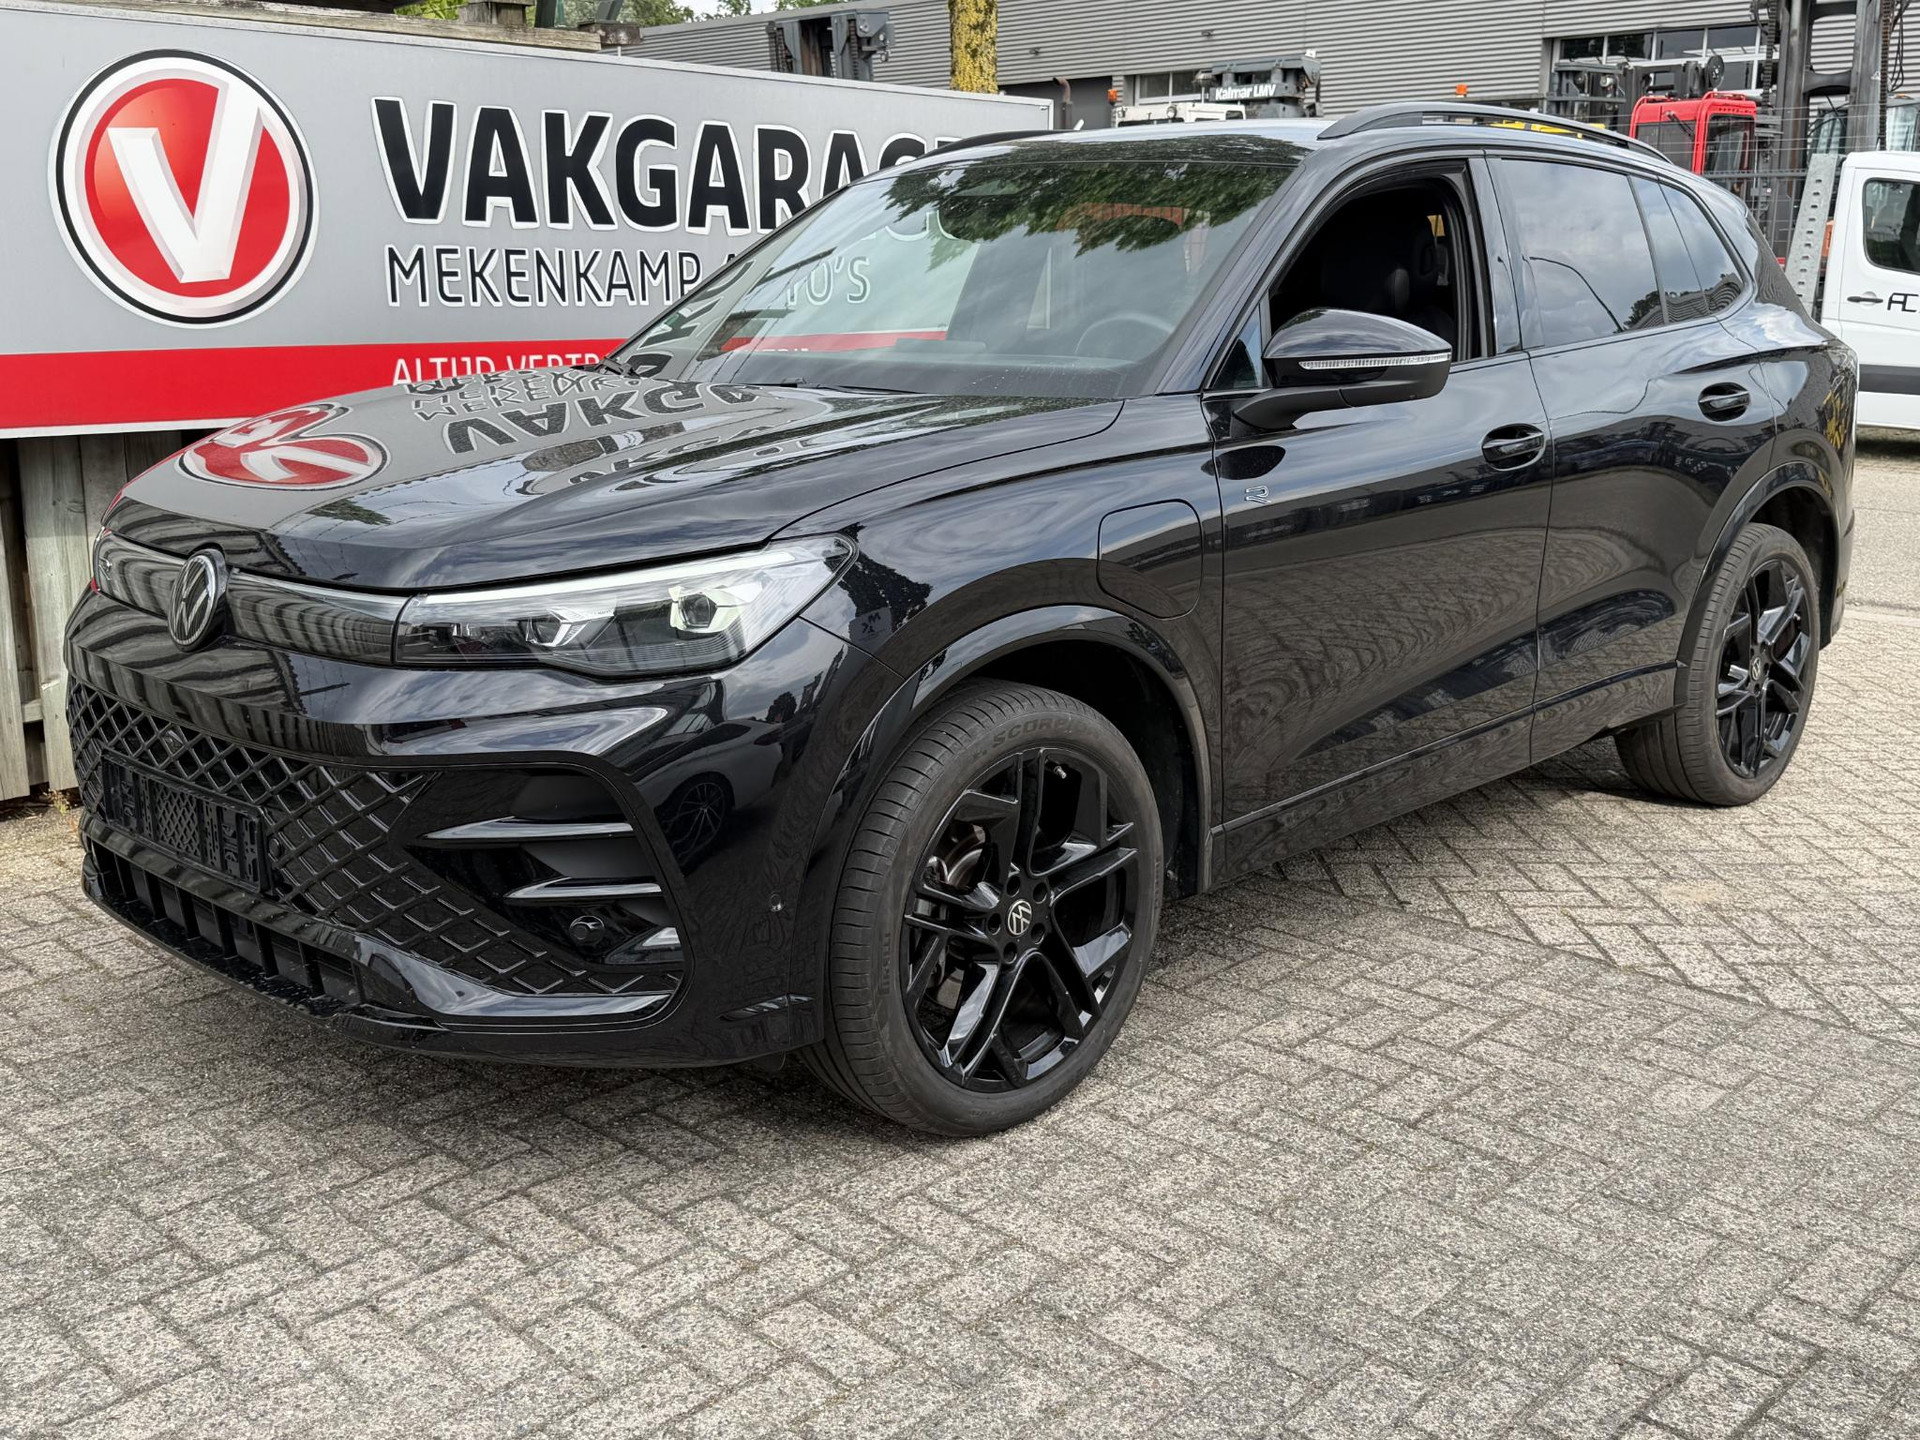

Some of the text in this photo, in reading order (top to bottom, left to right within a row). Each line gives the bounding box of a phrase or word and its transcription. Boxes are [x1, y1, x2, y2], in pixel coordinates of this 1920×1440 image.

[1215, 84, 1277, 101] Kalmar LMV
[384, 244, 702, 307] MEKENKAMP
